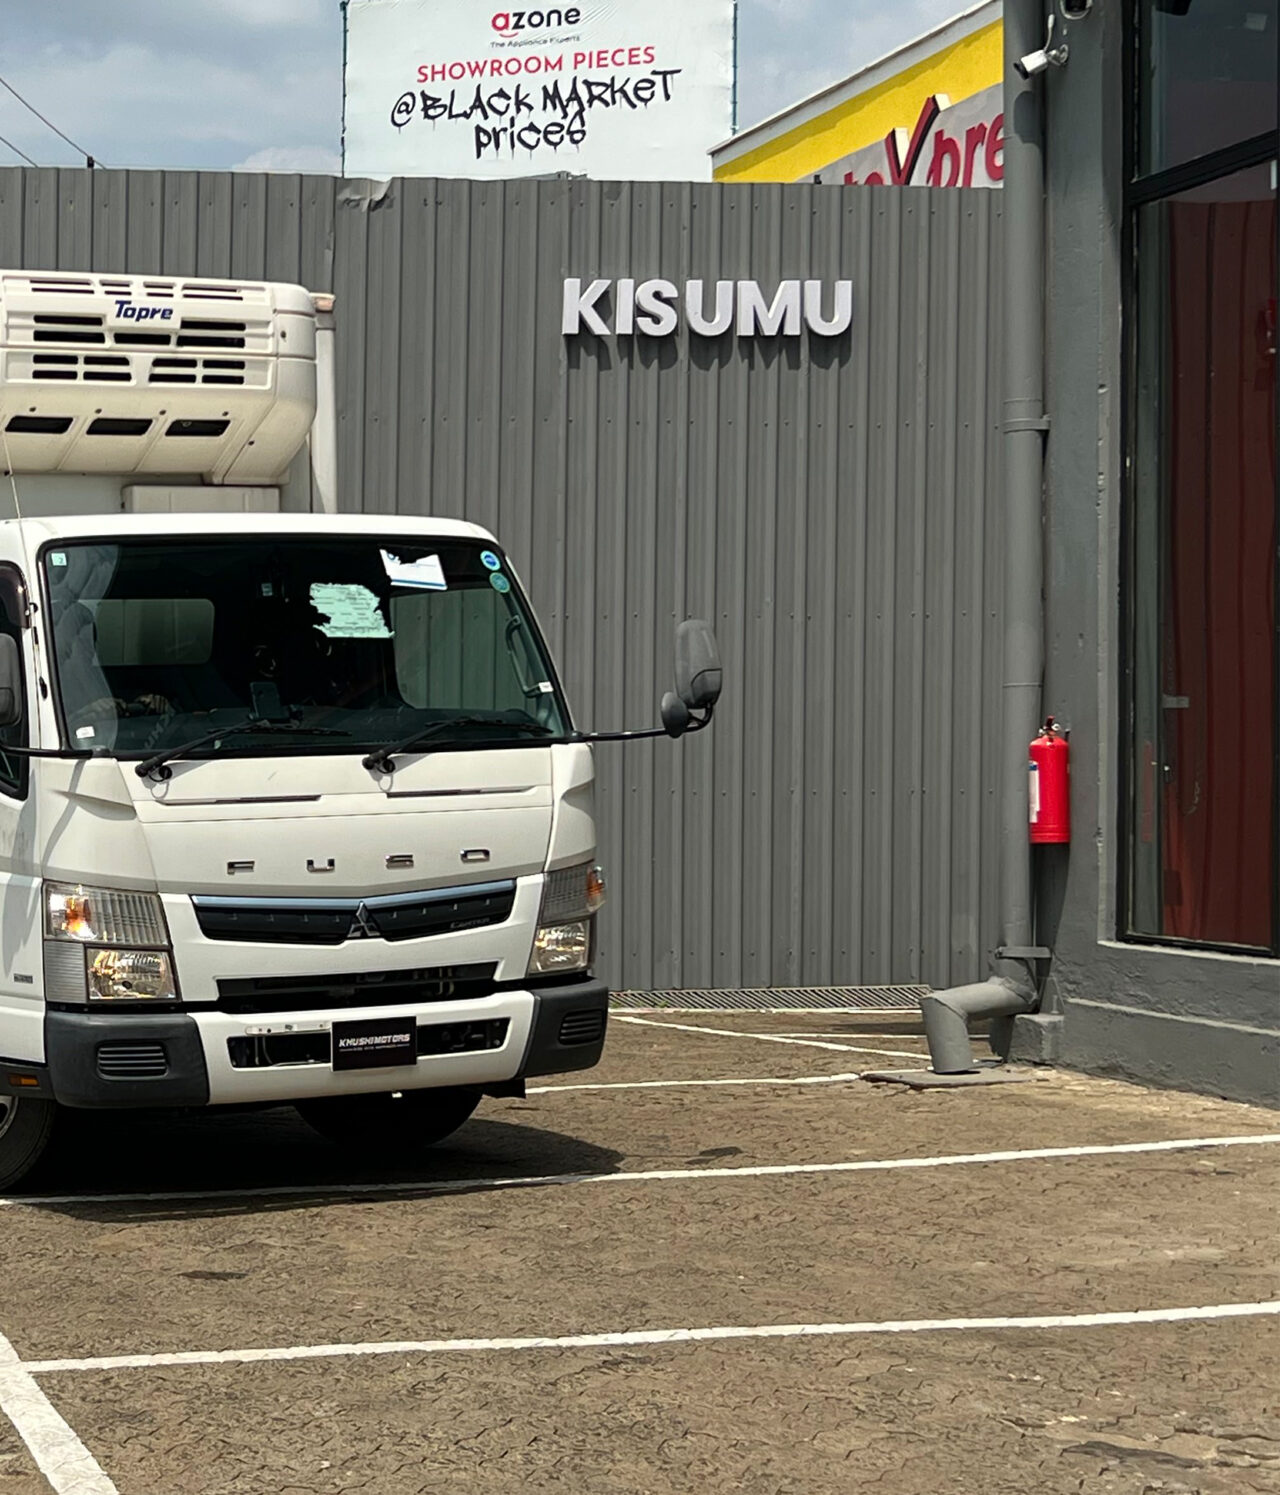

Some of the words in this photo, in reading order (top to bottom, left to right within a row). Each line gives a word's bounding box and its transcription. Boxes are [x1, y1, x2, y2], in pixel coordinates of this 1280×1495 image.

[491, 7, 581, 31] azone
[416, 54, 564, 84] SHOWROOM
[573, 46, 656, 71] PIECES
[114, 300, 174, 322] Topre
[562, 278, 853, 336] KISUMU
[227, 848, 490, 875] FUSO
[338, 1033, 411, 1048] KHUSHIMOTORS
